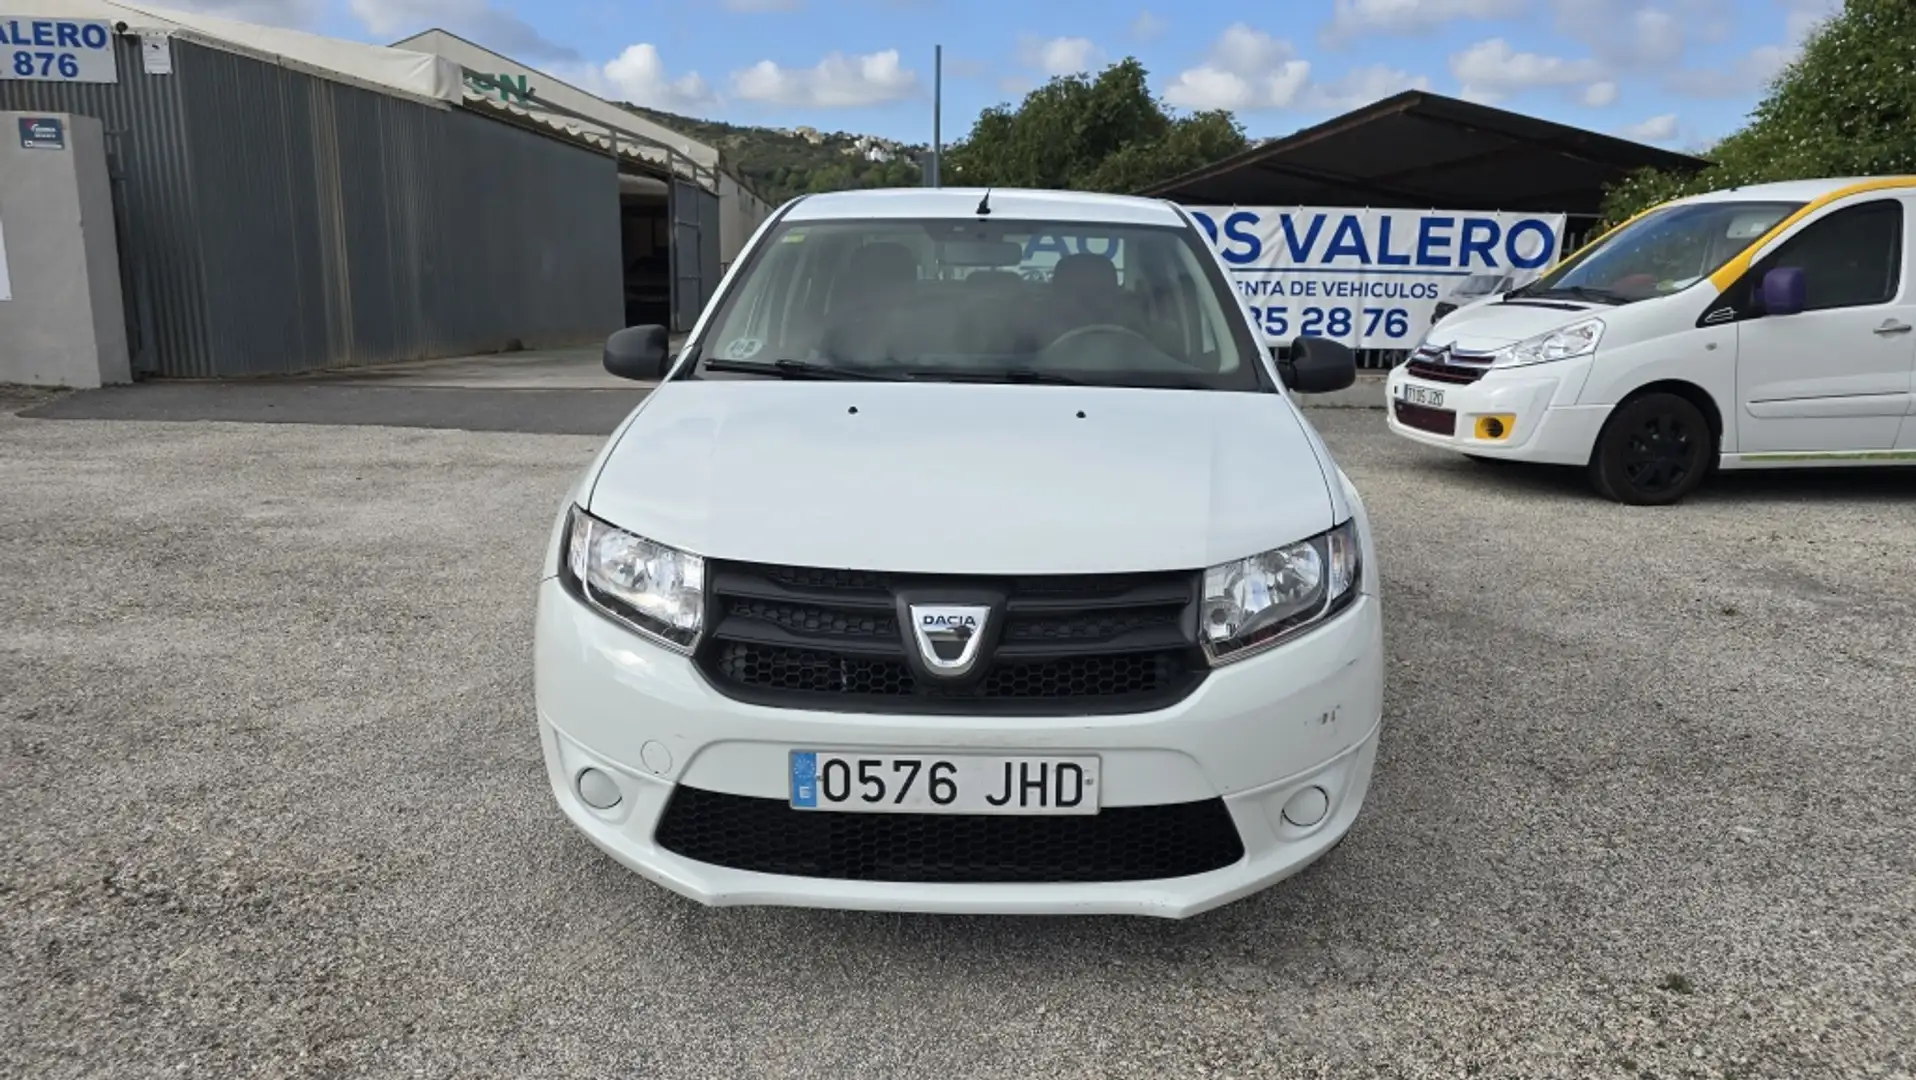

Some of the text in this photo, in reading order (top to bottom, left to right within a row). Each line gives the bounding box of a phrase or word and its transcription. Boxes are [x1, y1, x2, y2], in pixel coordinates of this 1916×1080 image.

[13, 51, 78, 78] 876
[1279, 214, 1555, 269] VALERO
[1290, 281, 1317, 297] DE
[1322, 283, 1439, 299] VEHICULOS
[1300, 307, 1352, 337] 28
[1363, 308, 1408, 338] 76
[923, 615, 976, 626] DACIA
[822, 758, 957, 805] 0576
[985, 761, 1083, 808] JHD
